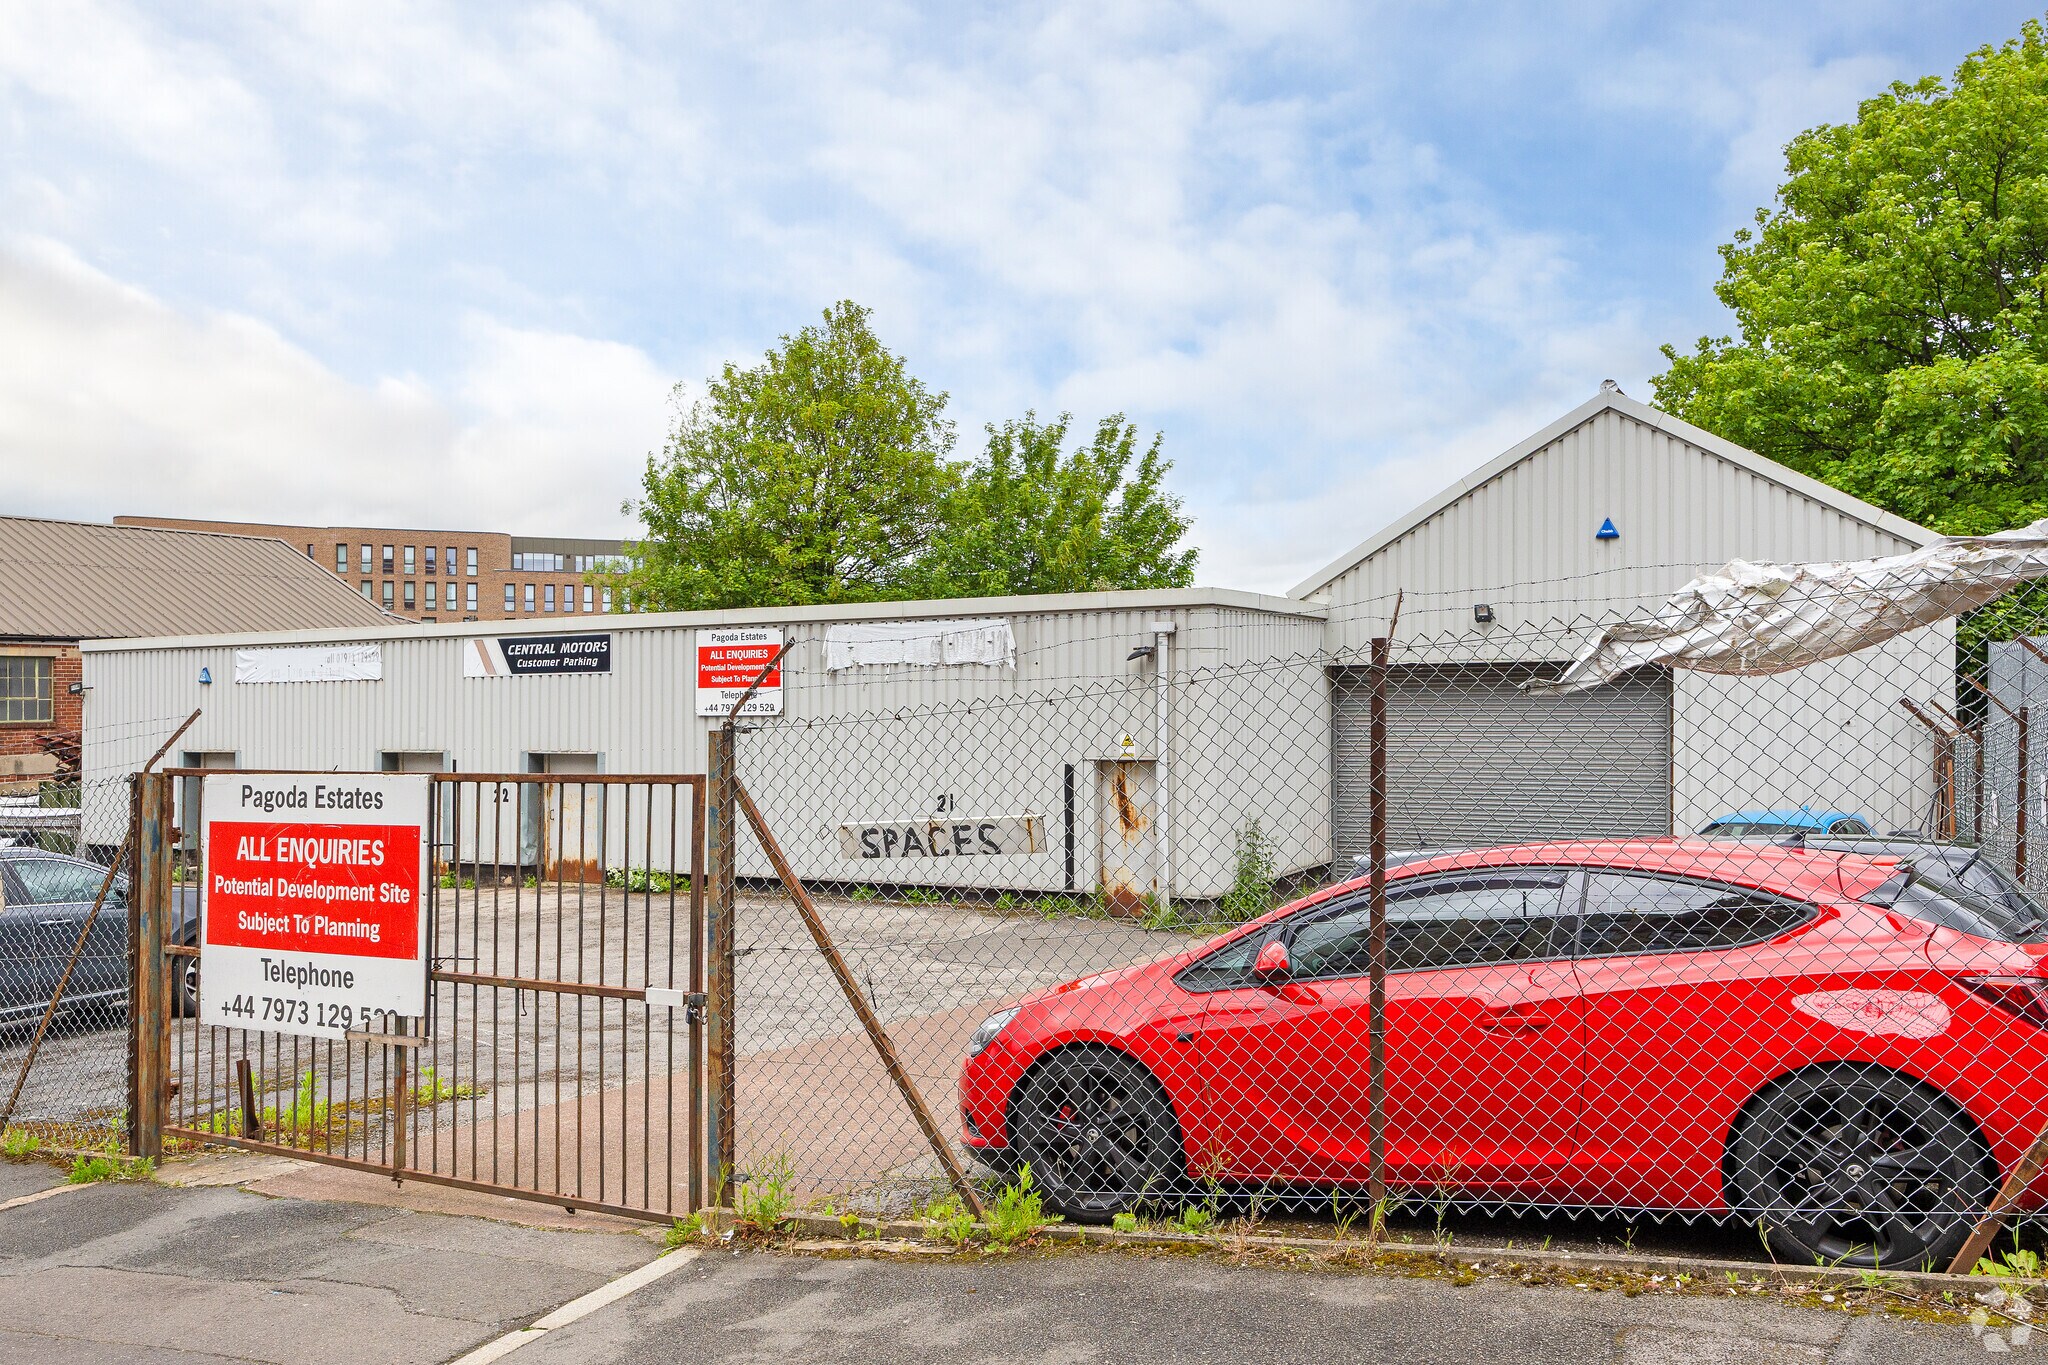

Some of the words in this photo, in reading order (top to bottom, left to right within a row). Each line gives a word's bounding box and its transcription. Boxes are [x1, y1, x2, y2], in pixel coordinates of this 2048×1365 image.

[711, 633, 739, 643] Pagoda
[741, 632, 768, 641] Estates
[508, 643, 556, 656] CENTRAL
[560, 641, 608, 653] MOTORS
[710, 650, 725, 660] ALL
[726, 649, 769, 660] ENQUIRIES
[517, 657, 560, 668] Customer
[563, 656, 599, 667] Parking
[701, 663, 727, 672] Potential
[727, 663, 765, 672] Development
[711, 675, 733, 684] Subject
[734, 674, 741, 682] To
[704, 704, 719, 712] +44
[721, 703, 737, 712] 797
[742, 703, 757, 712] 129
[241, 784, 308, 812] Pagoda
[315, 785, 384, 810] Estates
[937, 793, 954, 813] 21
[861, 823, 1000, 859] SPACES
[236, 836, 271, 862] ALL
[277, 837, 385, 869] ENQUIRIES
[215, 875, 273, 897] Potential
[277, 878, 375, 904] Development
[379, 883, 410, 904] Site
[238, 911, 290, 935] Subject
[293, 914, 310, 934] To
[314, 915, 381, 942] Planning
[260, 957, 354, 989] Telephone
[221, 994, 255, 1019] +44
[262, 997, 309, 1025] 7973
[316, 1002, 353, 1030] 129
